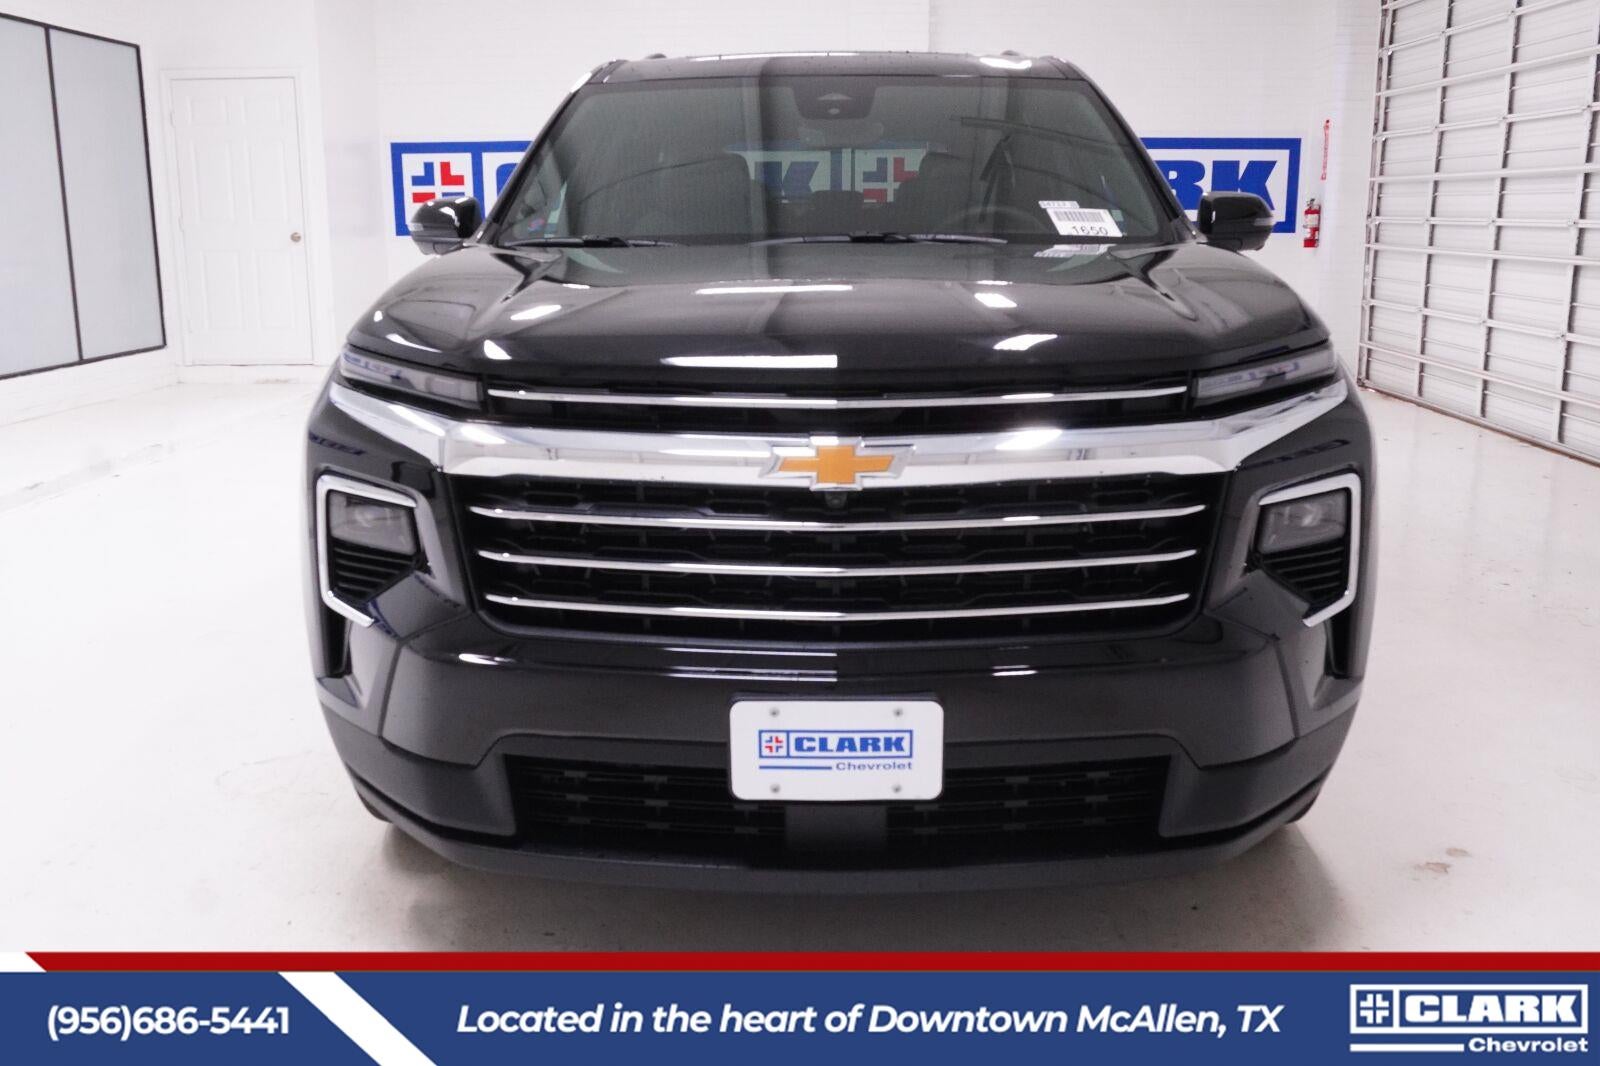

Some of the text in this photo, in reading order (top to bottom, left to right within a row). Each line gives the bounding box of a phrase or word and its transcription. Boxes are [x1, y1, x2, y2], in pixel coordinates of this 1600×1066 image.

[1071, 225, 1109, 236] 1650
[794, 736, 905, 752] CLARK
[835, 761, 912, 771] Chevrolet
